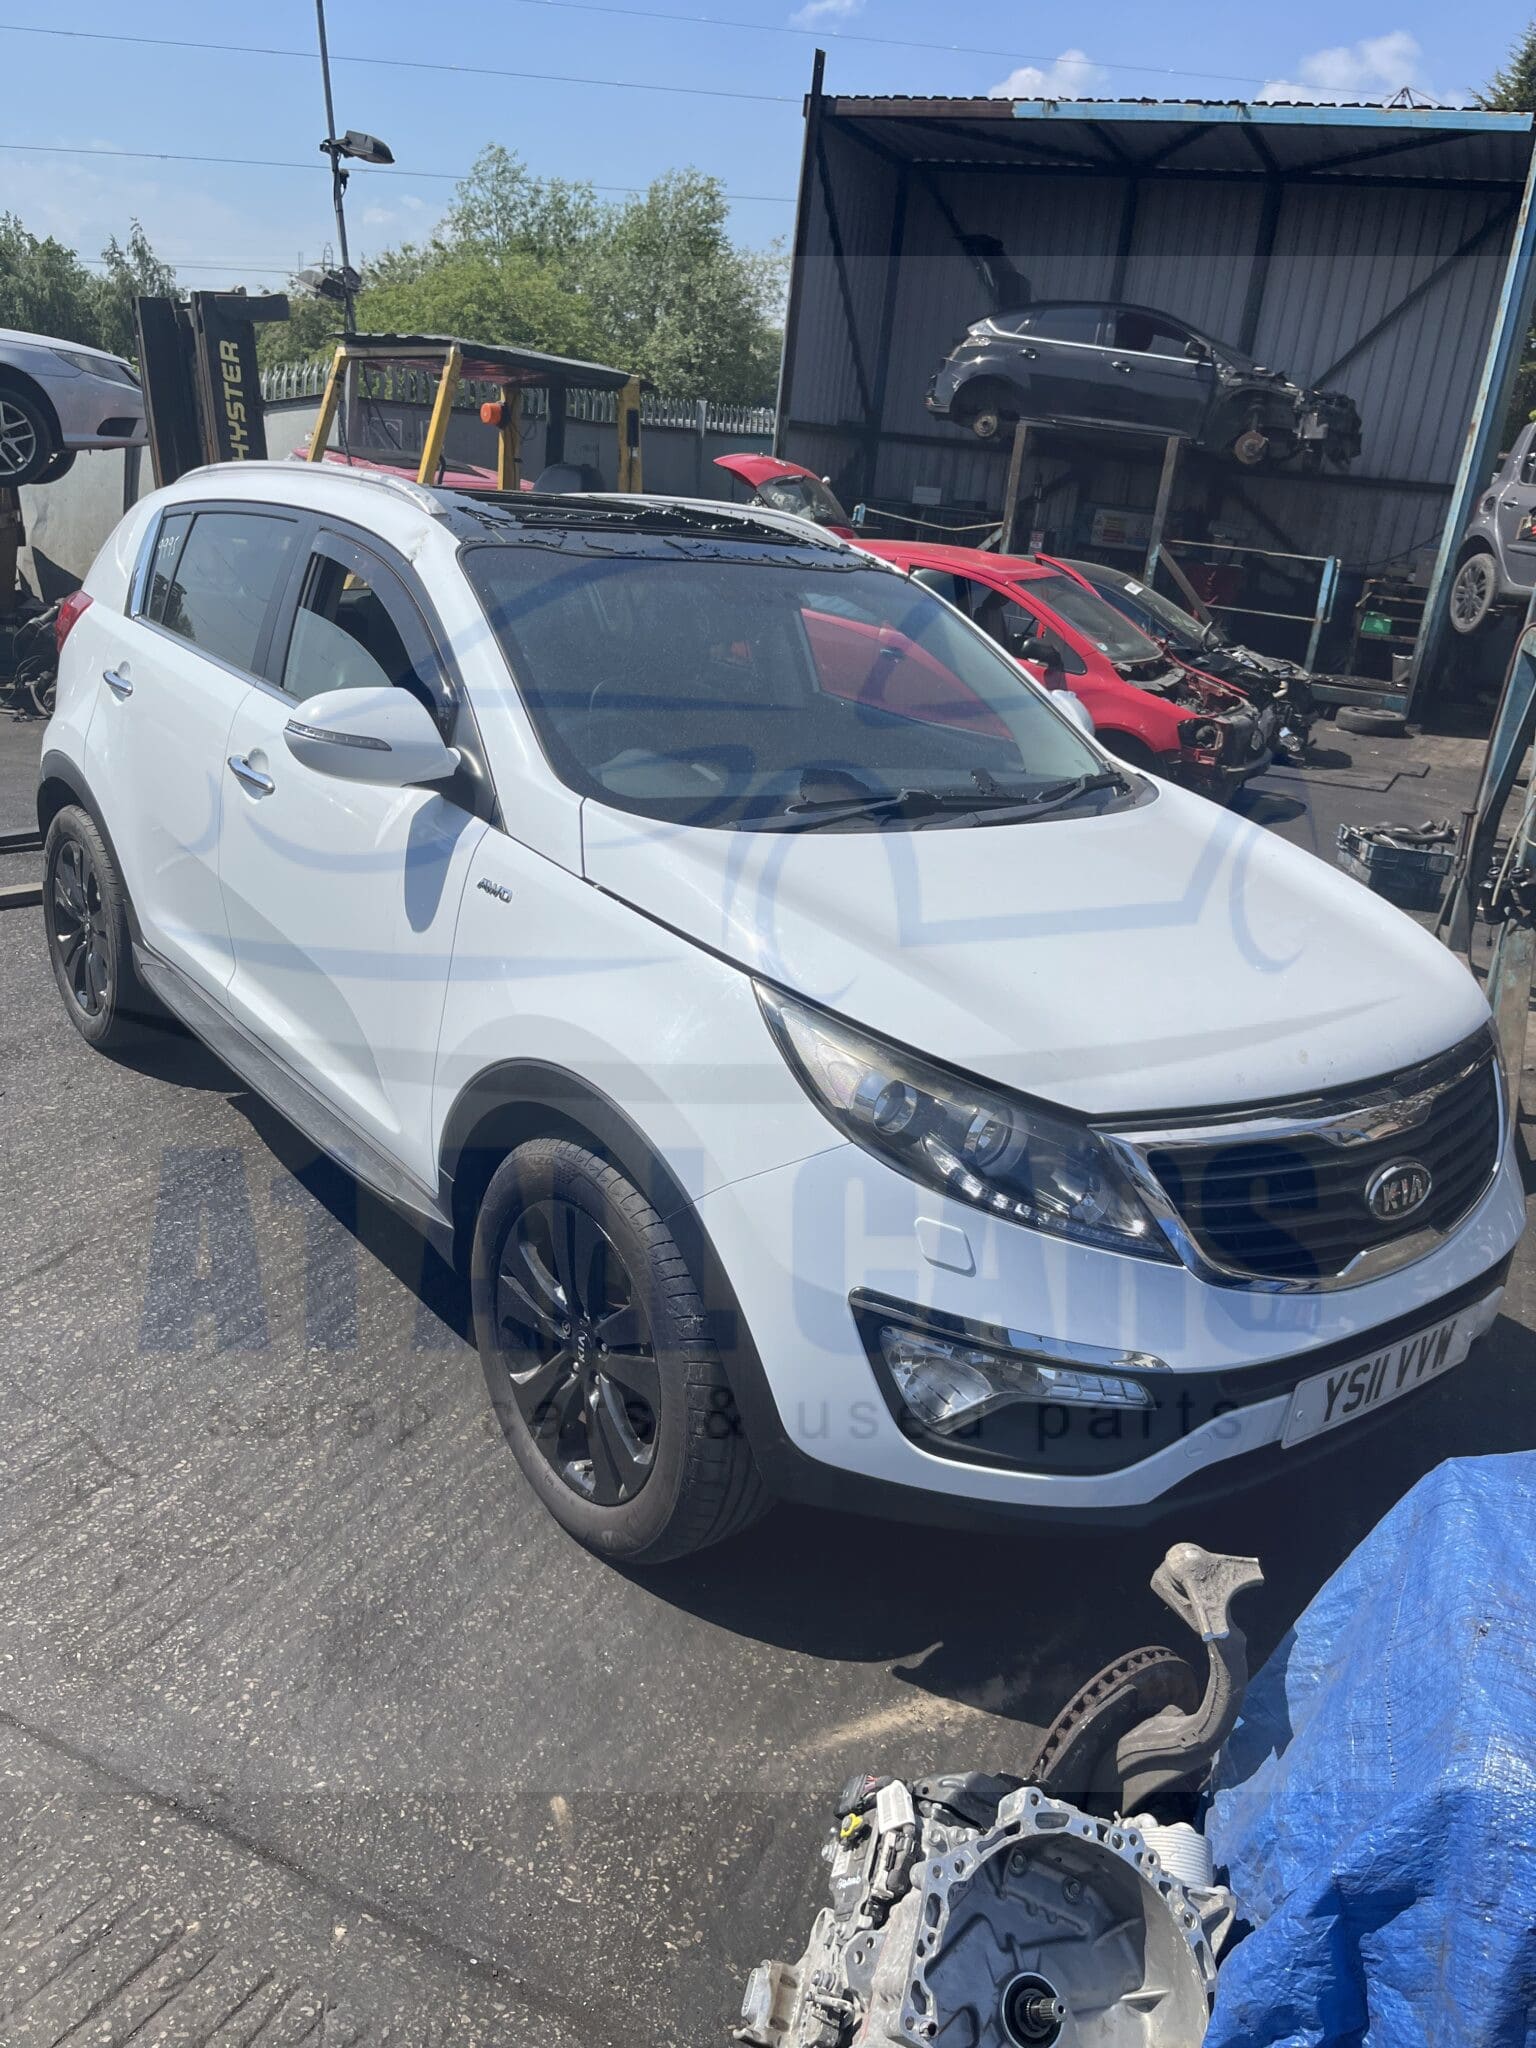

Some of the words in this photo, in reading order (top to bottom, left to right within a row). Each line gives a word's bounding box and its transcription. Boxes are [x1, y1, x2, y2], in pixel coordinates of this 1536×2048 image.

[219, 340, 250, 461] HYSTER
[477, 878, 513, 904] AWD
[1382, 1174, 1424, 1213] KIA
[1324, 1353, 1391, 1423] YS11
